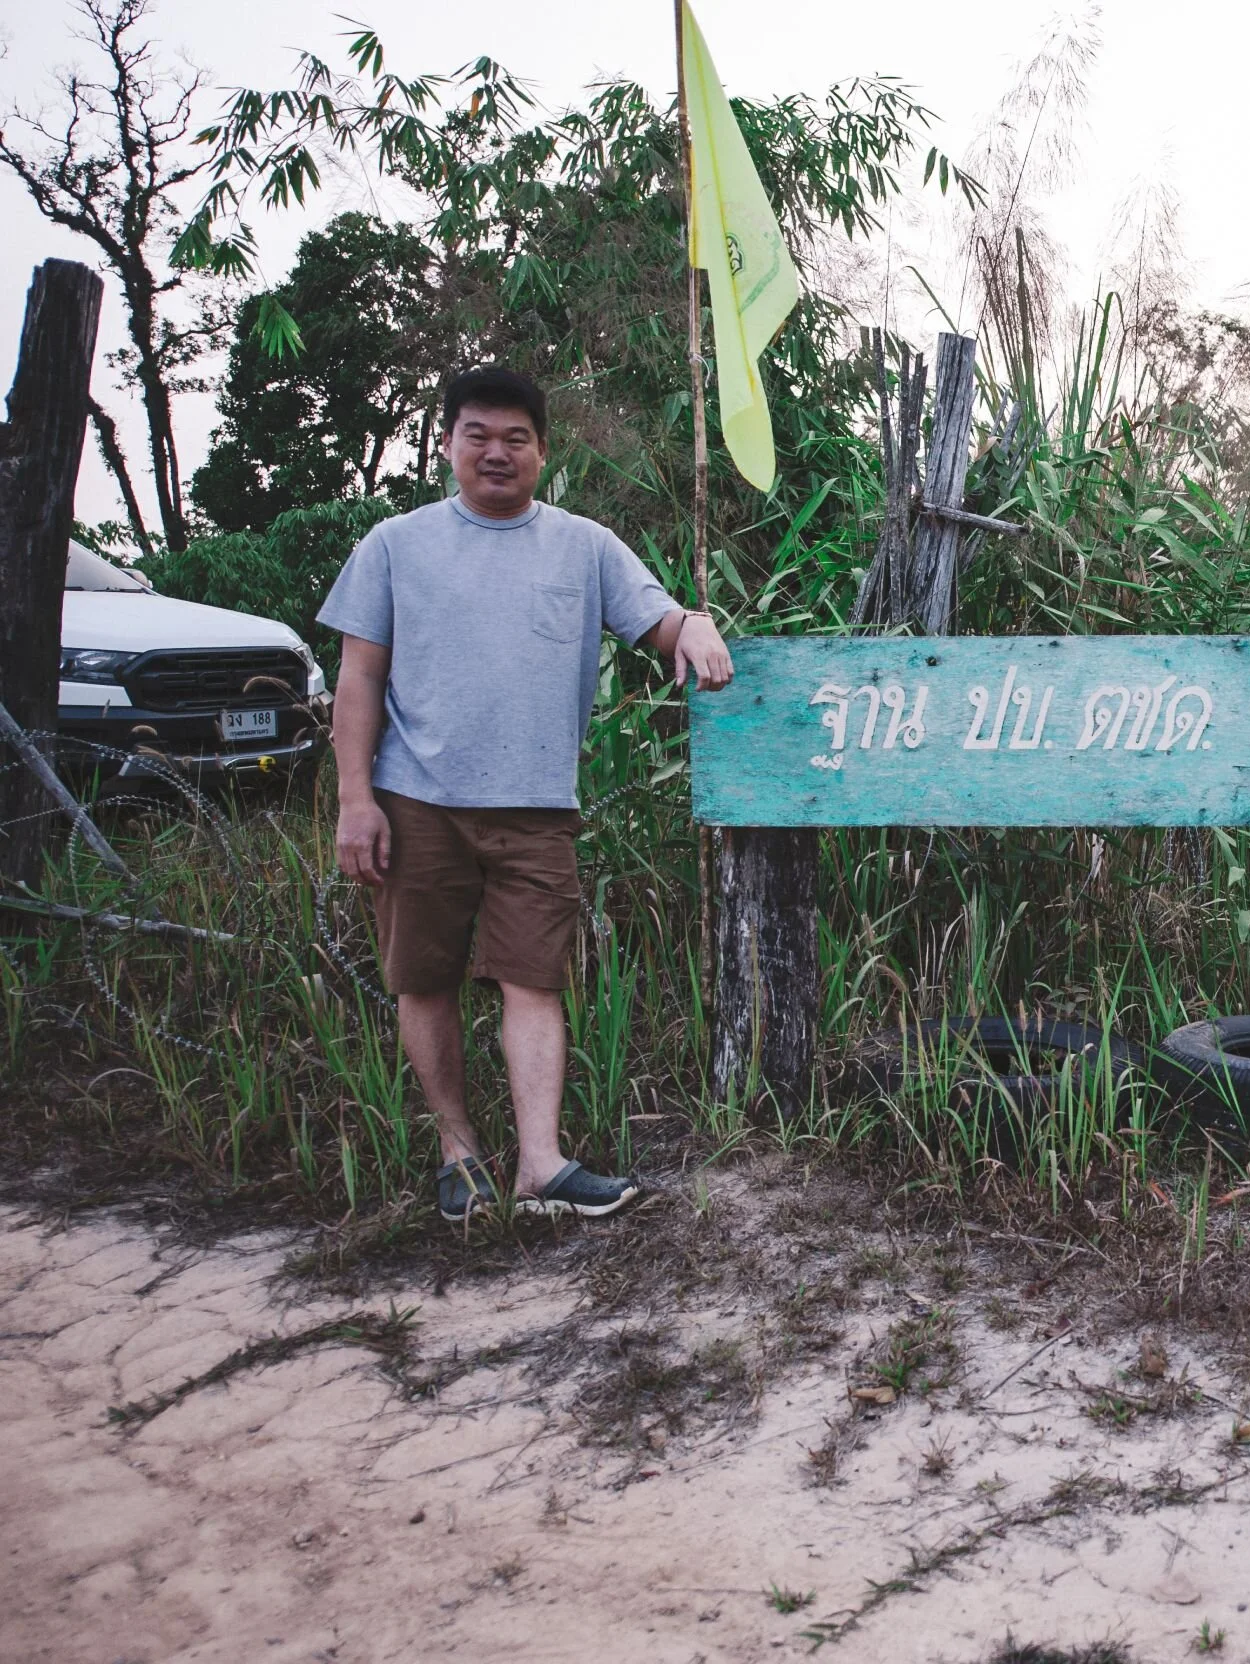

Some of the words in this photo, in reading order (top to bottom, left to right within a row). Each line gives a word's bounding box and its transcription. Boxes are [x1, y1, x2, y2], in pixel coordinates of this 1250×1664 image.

[253, 712, 271, 725] 188
[808, 683, 929, 770] ฐาน
[963, 665, 1055, 750] ปบ.
[1075, 675, 1212, 751] ตชด.
